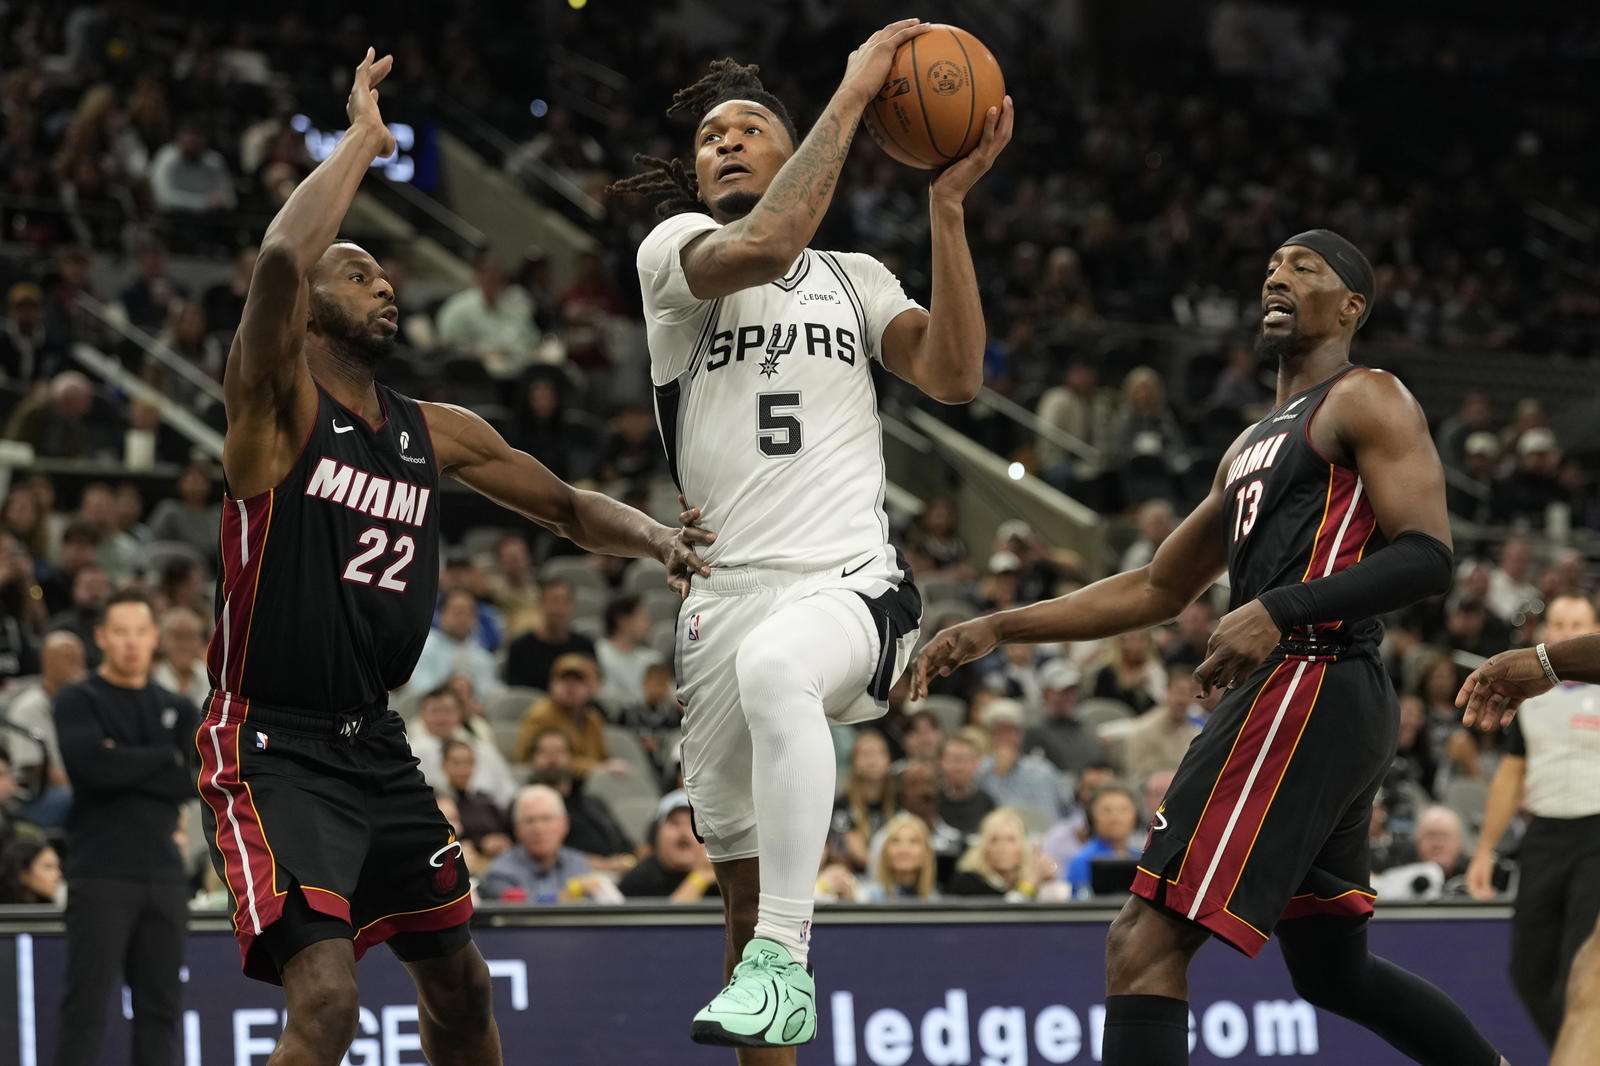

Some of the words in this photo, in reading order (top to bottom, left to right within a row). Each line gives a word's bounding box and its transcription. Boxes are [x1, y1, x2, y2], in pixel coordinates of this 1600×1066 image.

[803, 293, 835, 302] LEDGER
[707, 322, 856, 379] SPURS
[756, 390, 804, 459] 5
[304, 456, 431, 528] MIAMI
[1234, 479, 1263, 542] 13
[342, 526, 415, 593] 22
